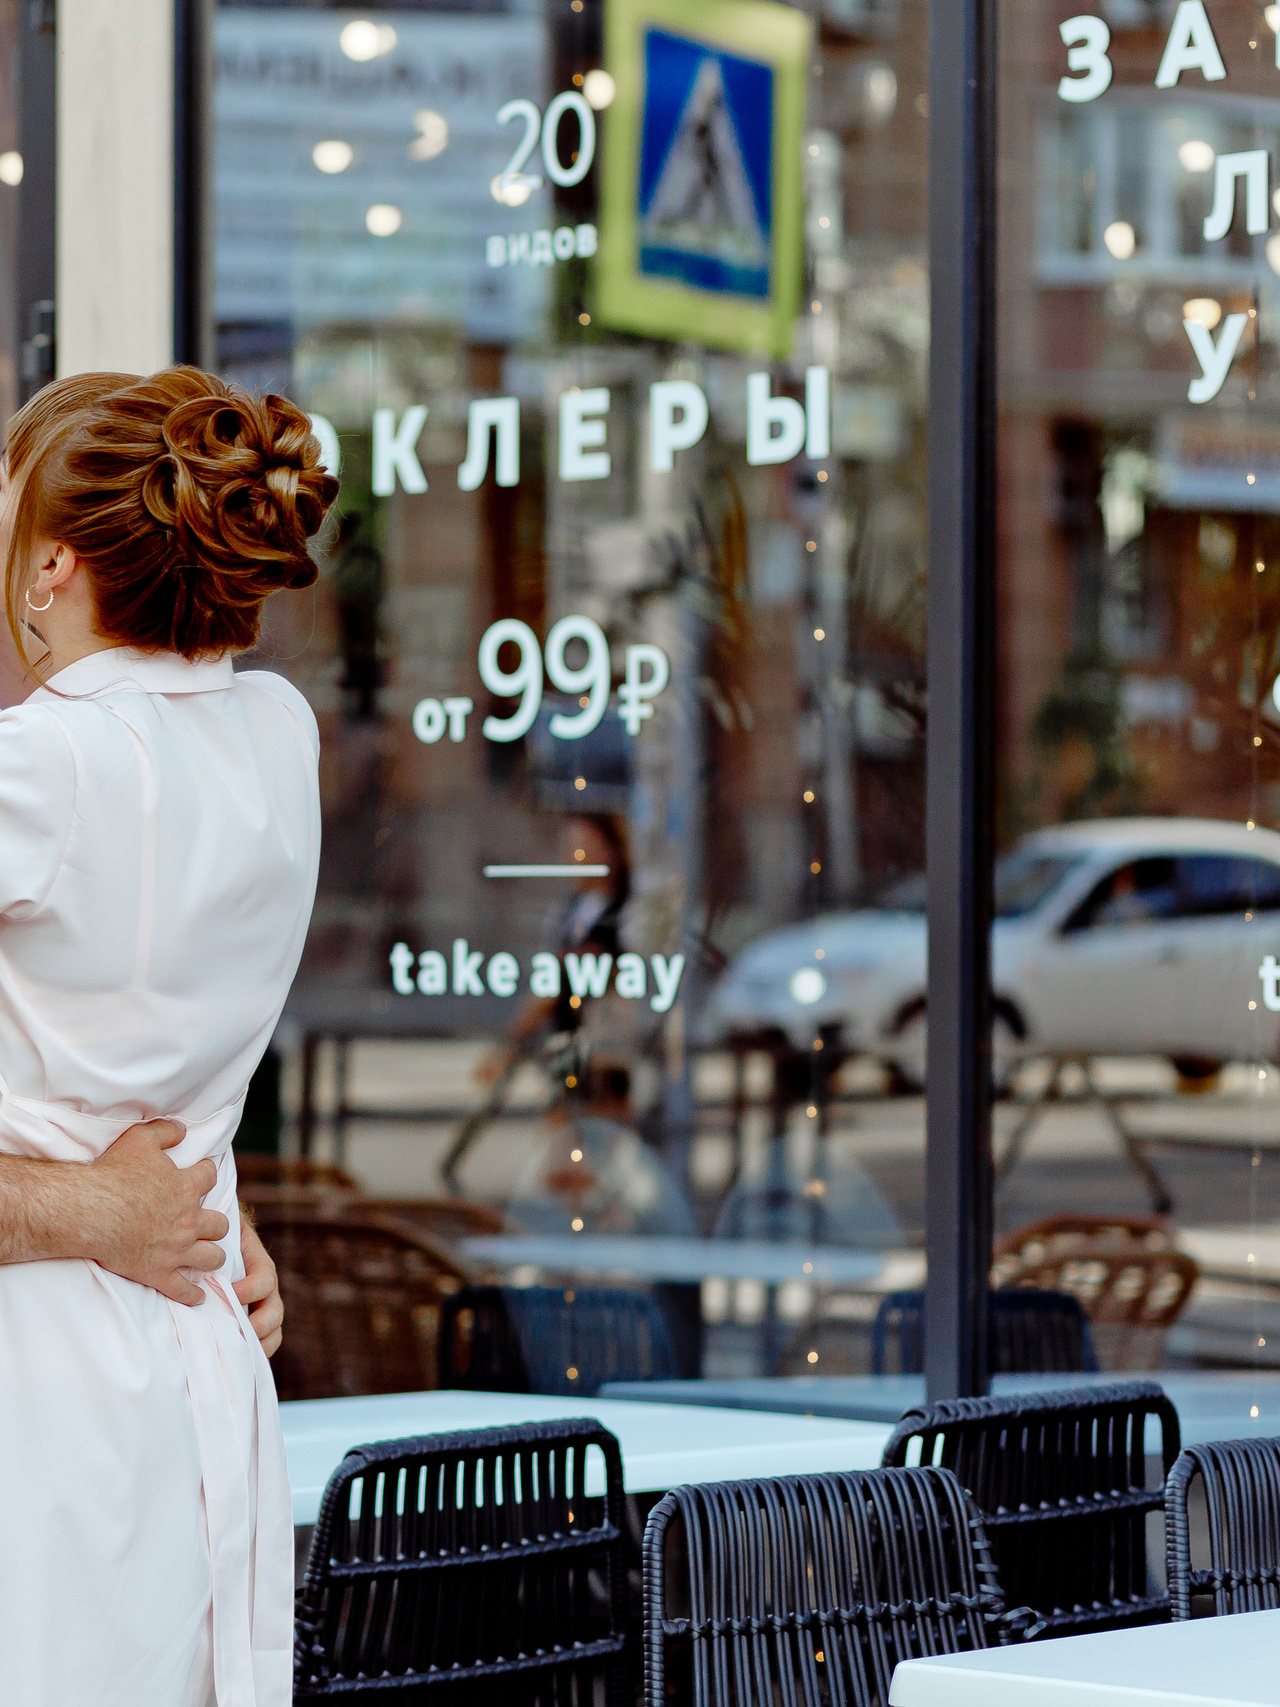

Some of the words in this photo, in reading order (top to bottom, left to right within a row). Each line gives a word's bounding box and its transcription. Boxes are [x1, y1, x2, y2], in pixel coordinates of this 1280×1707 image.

[1057, 0, 1280, 102] ЗА
[495, 90, 596, 189] 20
[1203, 149, 1269, 241] Л
[486, 223, 597, 268] видов
[412, 697, 474, 743] от
